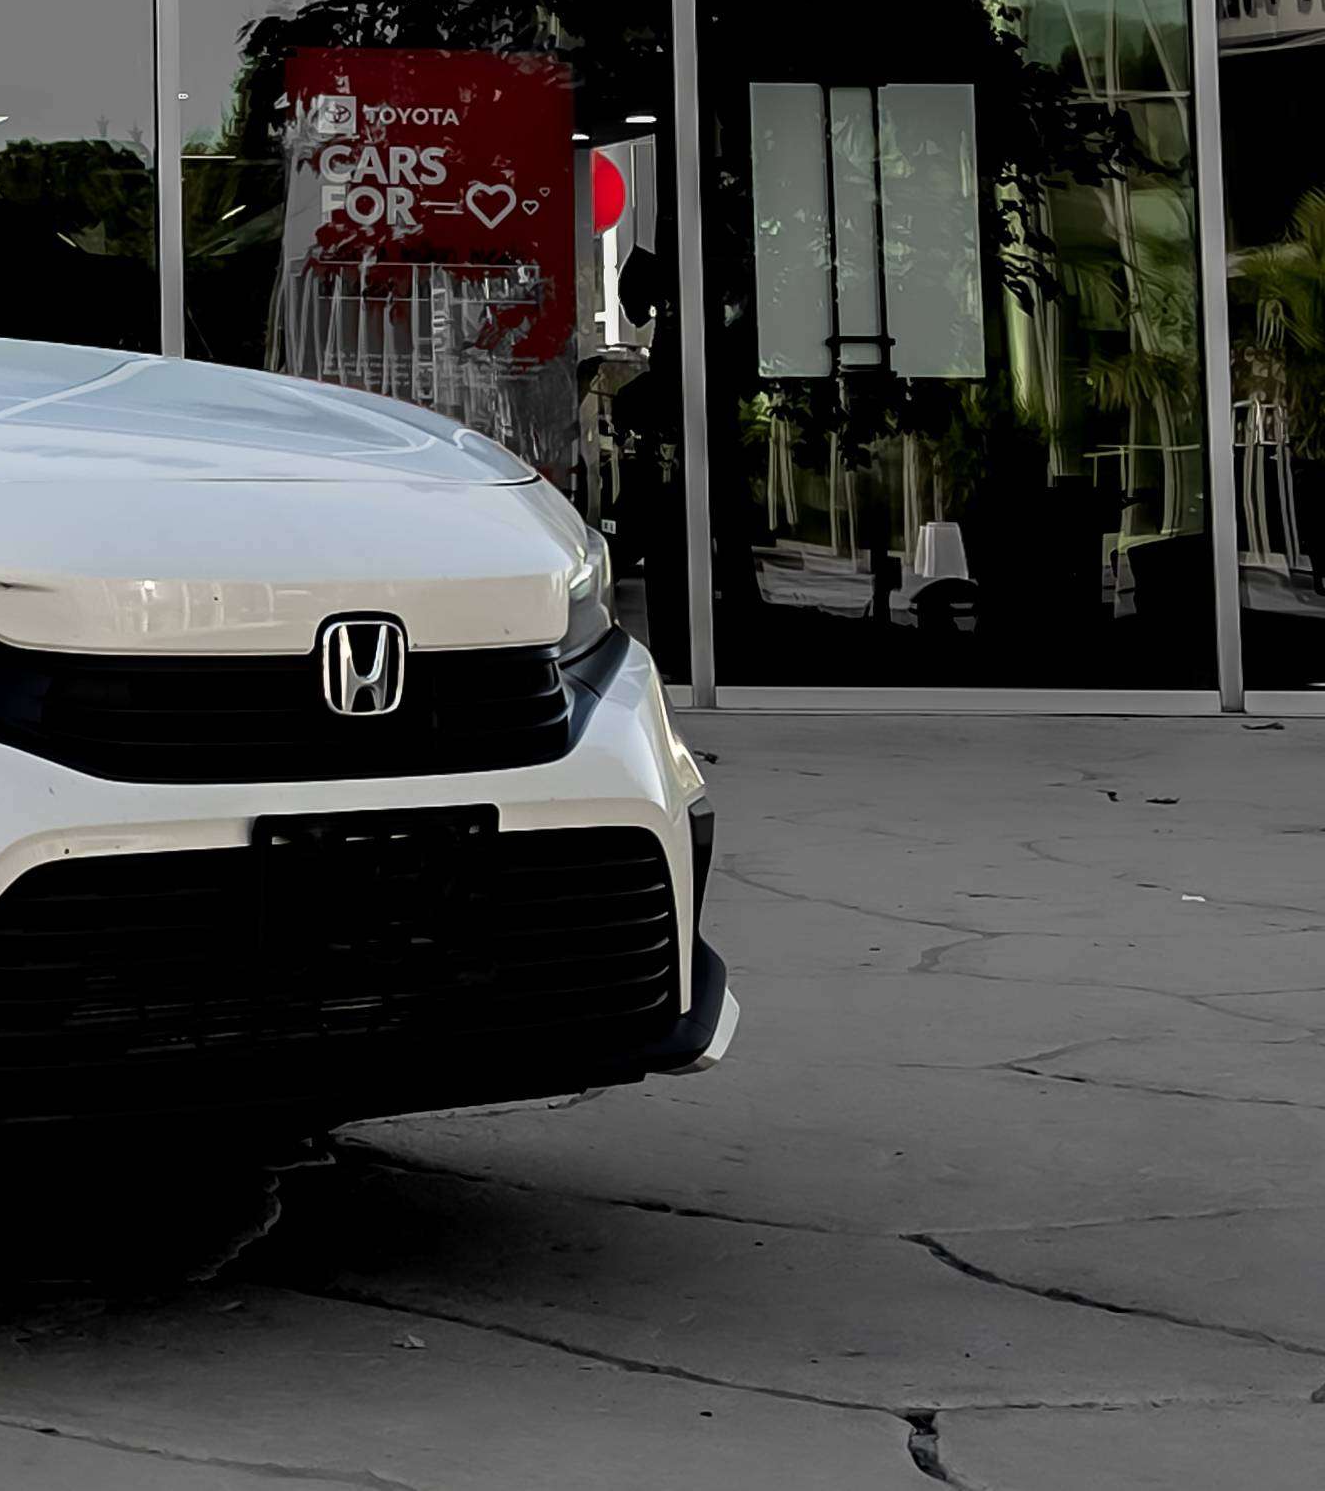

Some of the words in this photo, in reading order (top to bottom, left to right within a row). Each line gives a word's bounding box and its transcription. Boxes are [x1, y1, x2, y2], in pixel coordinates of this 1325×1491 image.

[363, 106, 460, 126] TOYOTA
[319, 144, 448, 186] CARS
[320, 185, 419, 227] FOR
